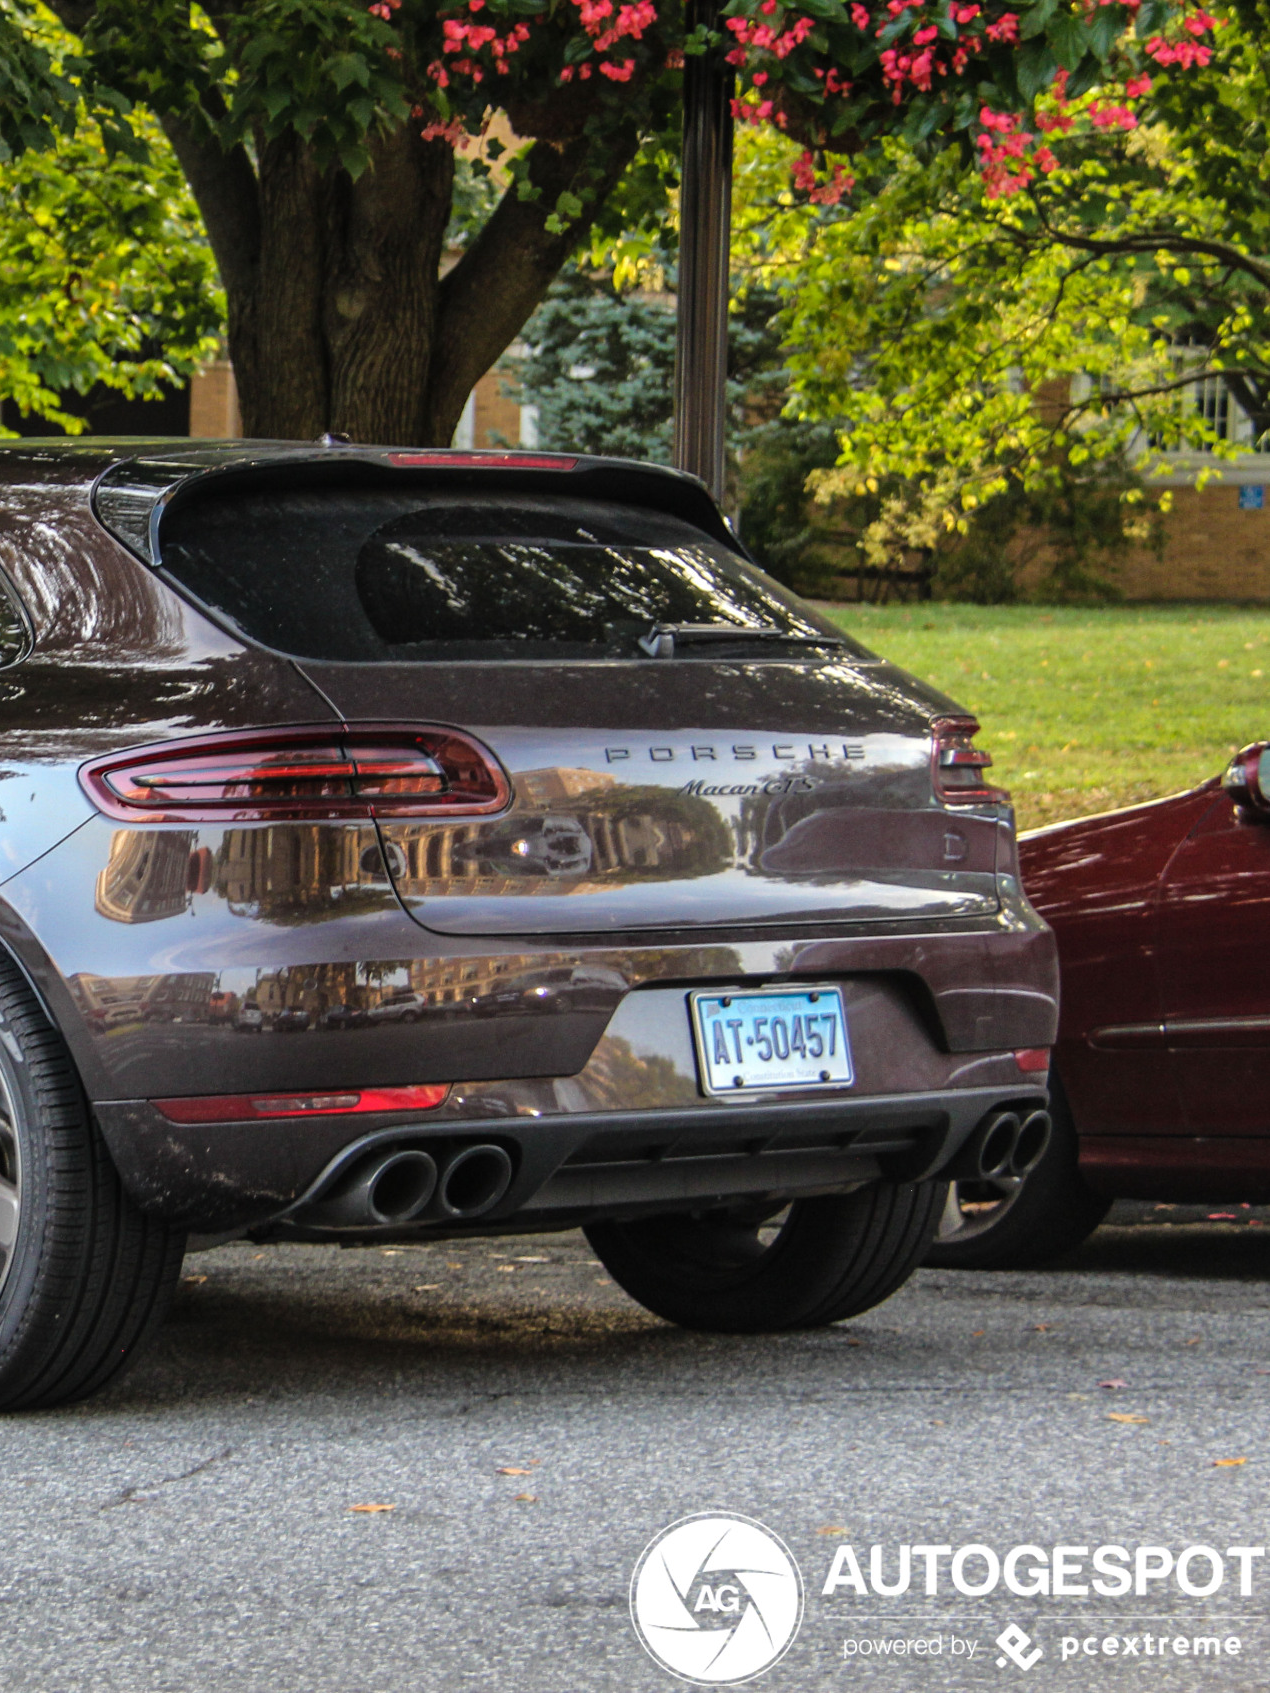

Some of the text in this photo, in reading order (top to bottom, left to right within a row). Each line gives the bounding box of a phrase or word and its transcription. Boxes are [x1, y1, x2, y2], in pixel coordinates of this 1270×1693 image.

[604, 743, 866, 764] PORSCHE
[680, 776, 824, 797] Macan GTS
